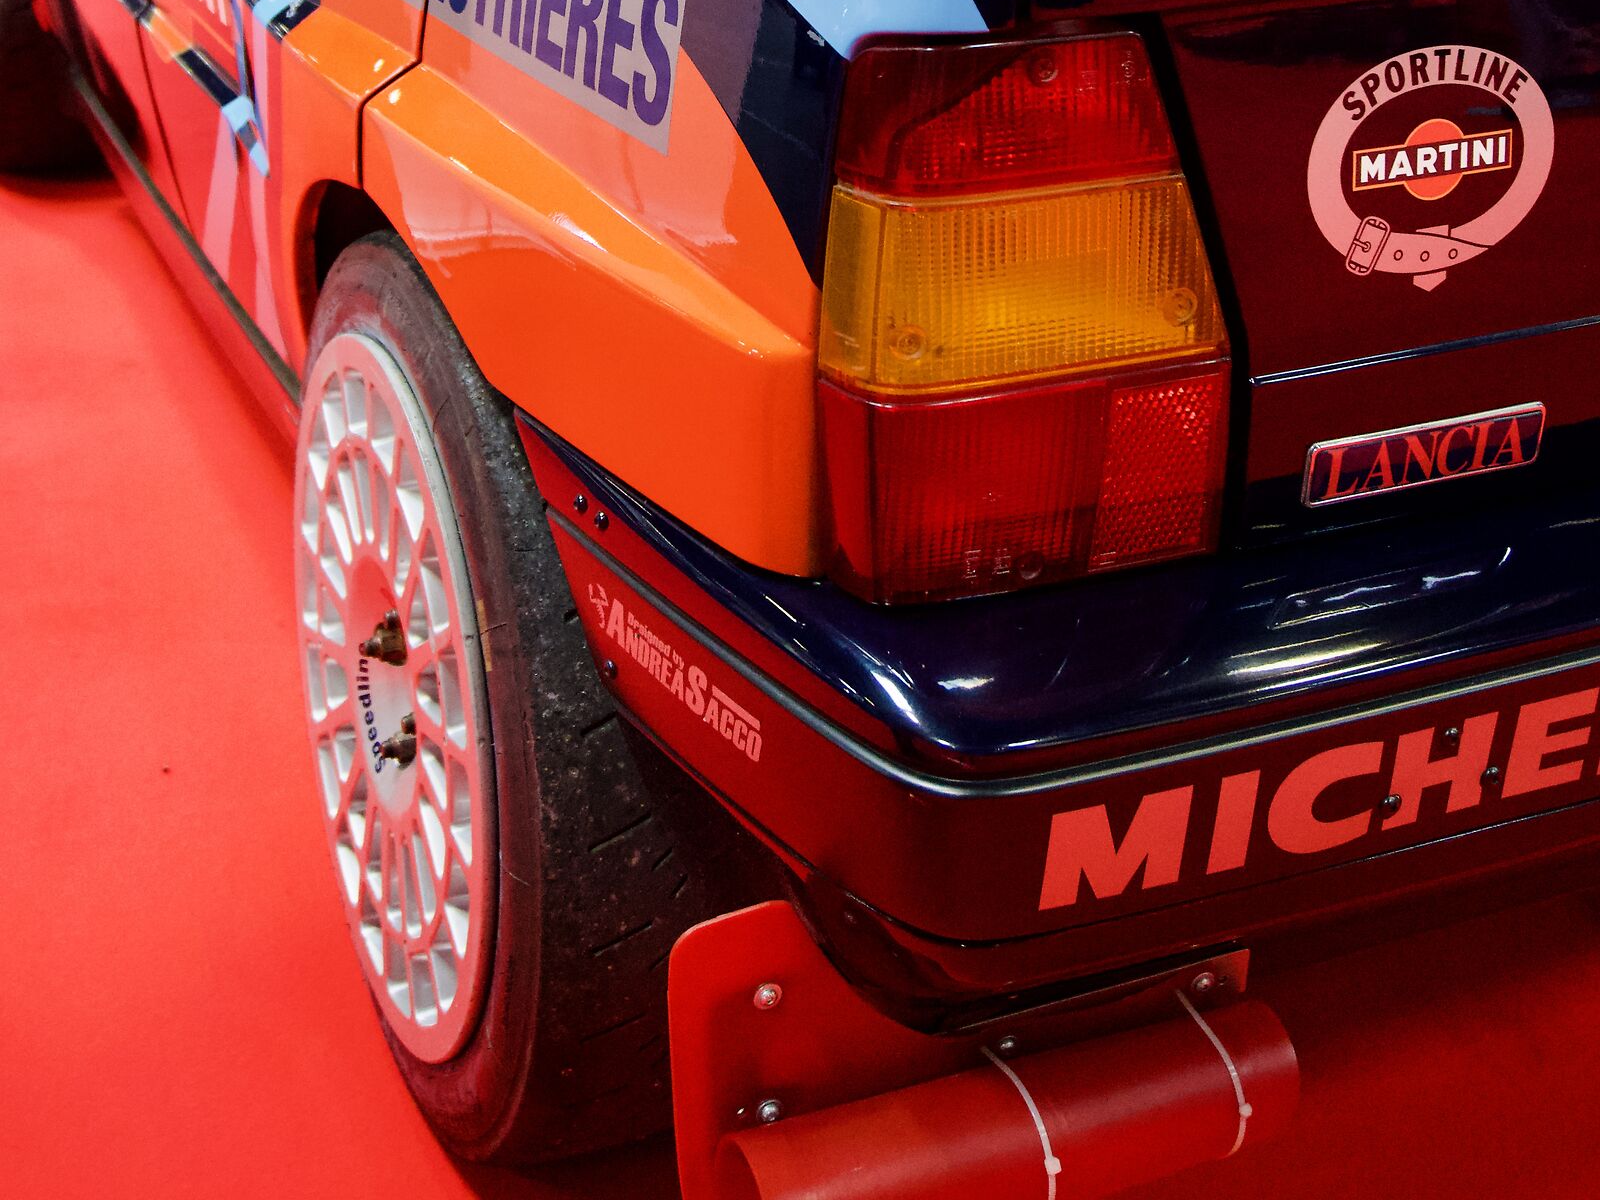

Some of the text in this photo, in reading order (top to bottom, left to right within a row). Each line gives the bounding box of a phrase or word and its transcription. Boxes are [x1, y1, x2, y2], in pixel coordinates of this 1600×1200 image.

[1342, 48, 1528, 121] SPORTLINE
[1360, 136, 1506, 183] MARTINI
[1320, 415, 1525, 501] LANCIA
[606, 598, 763, 762] ANDREA SACCO
[672, 649, 685, 670] by
[1038, 687, 1600, 912] MICHE
